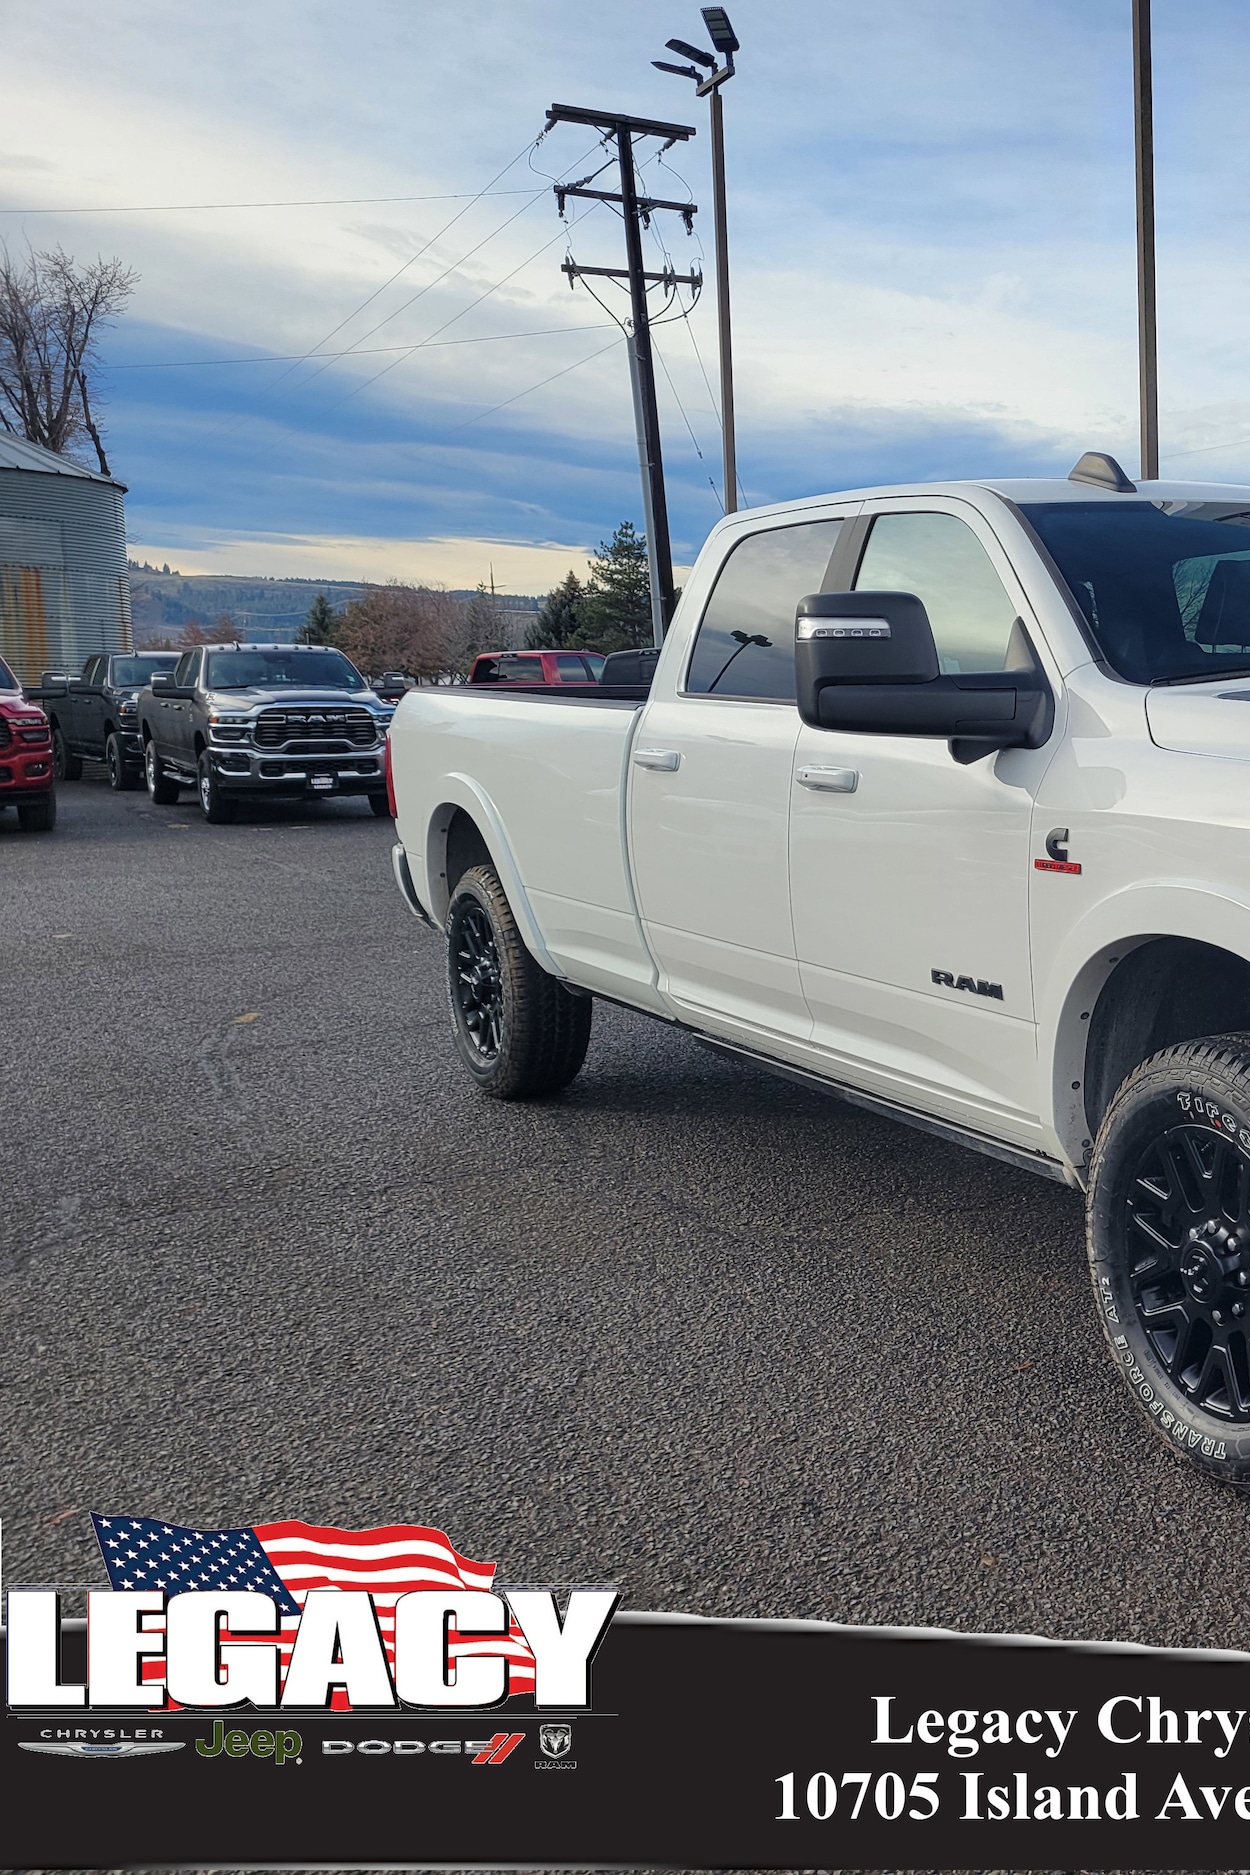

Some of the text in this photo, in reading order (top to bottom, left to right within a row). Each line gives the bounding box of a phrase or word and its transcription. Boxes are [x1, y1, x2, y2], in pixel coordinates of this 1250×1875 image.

[287, 714, 345, 723] RAM
[931, 967, 1005, 1001] RAM
[1114, 1334, 1227, 1460] TRANSFORCE
